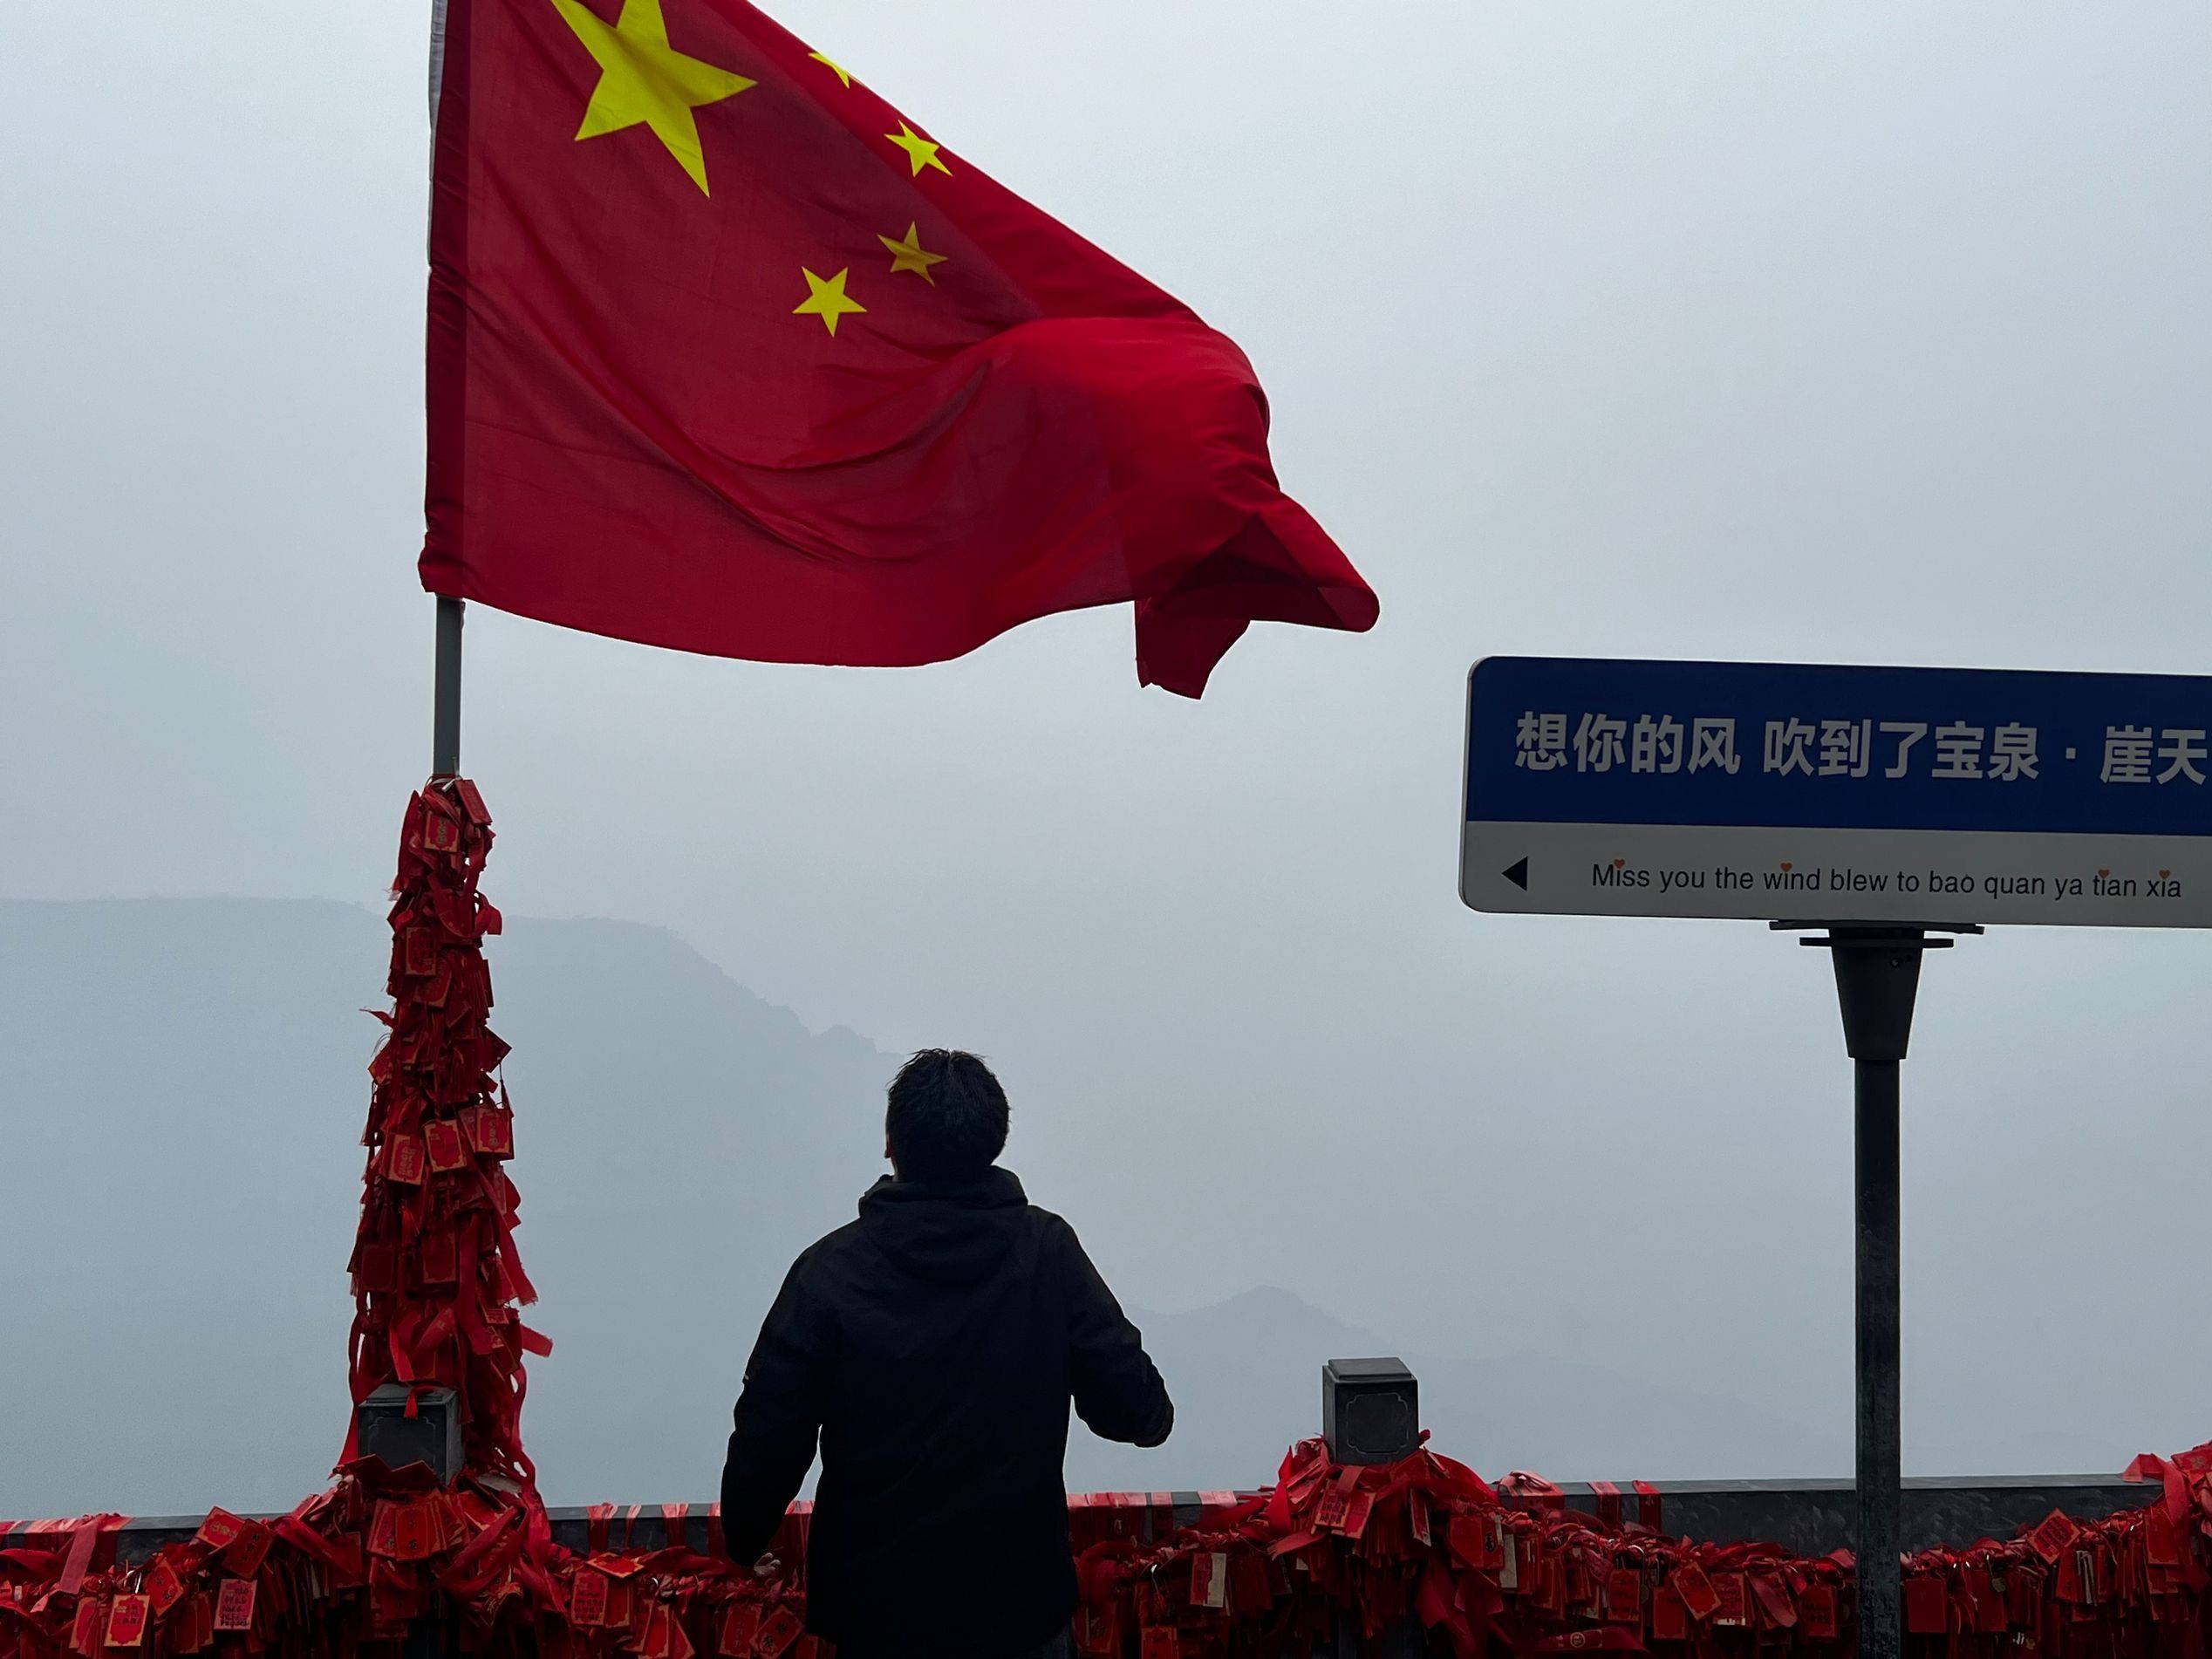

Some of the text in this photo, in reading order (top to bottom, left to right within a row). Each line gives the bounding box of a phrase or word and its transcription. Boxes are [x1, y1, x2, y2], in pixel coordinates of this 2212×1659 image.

[1514, 711, 1741, 775] 想你的风
[1592, 861, 2181, 901] Miss you the wind blew to bao quan ya tian xia
